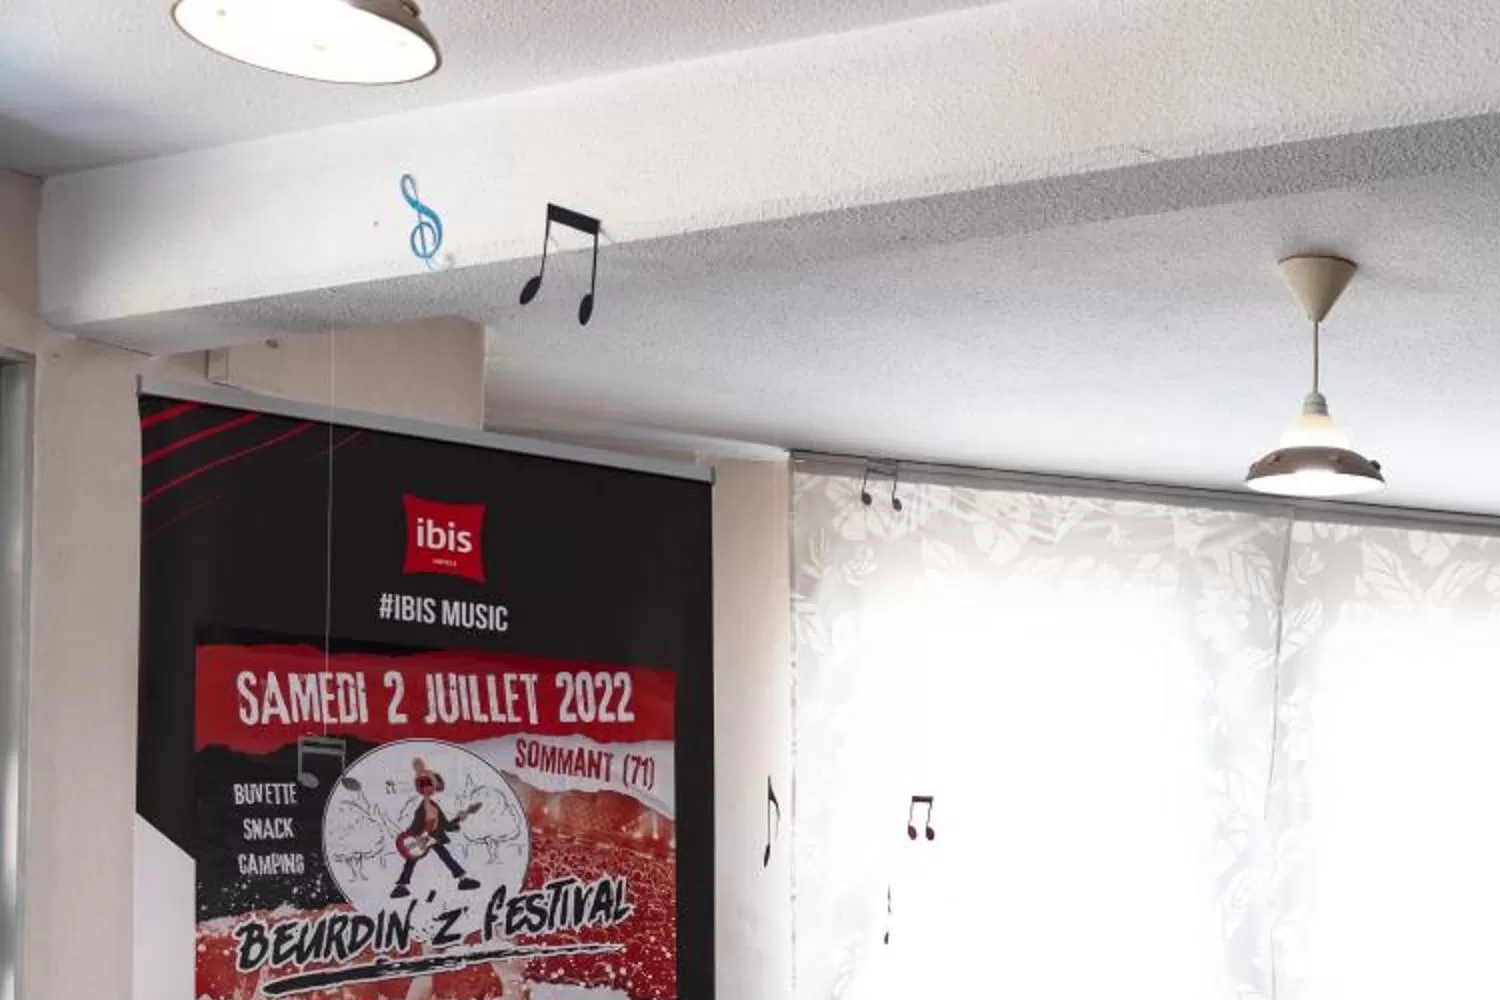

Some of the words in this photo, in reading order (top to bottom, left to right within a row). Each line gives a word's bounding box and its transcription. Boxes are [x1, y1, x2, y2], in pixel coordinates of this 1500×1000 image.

[416, 518, 473, 554] ibis
[379, 592, 436, 624] #IBIS
[441, 597, 509, 631] MUSIC
[236, 669, 367, 725] SAMEDI
[383, 670, 407, 725] 2
[425, 672, 538, 725] JUILLET
[555, 670, 635, 724] 2022
[515, 737, 613, 782] SOMMANT
[623, 753, 655, 791] (71)
[233, 783, 298, 805] BUVETTE
[243, 817, 294, 840] SNACK
[238, 853, 304, 876] CAMPING
